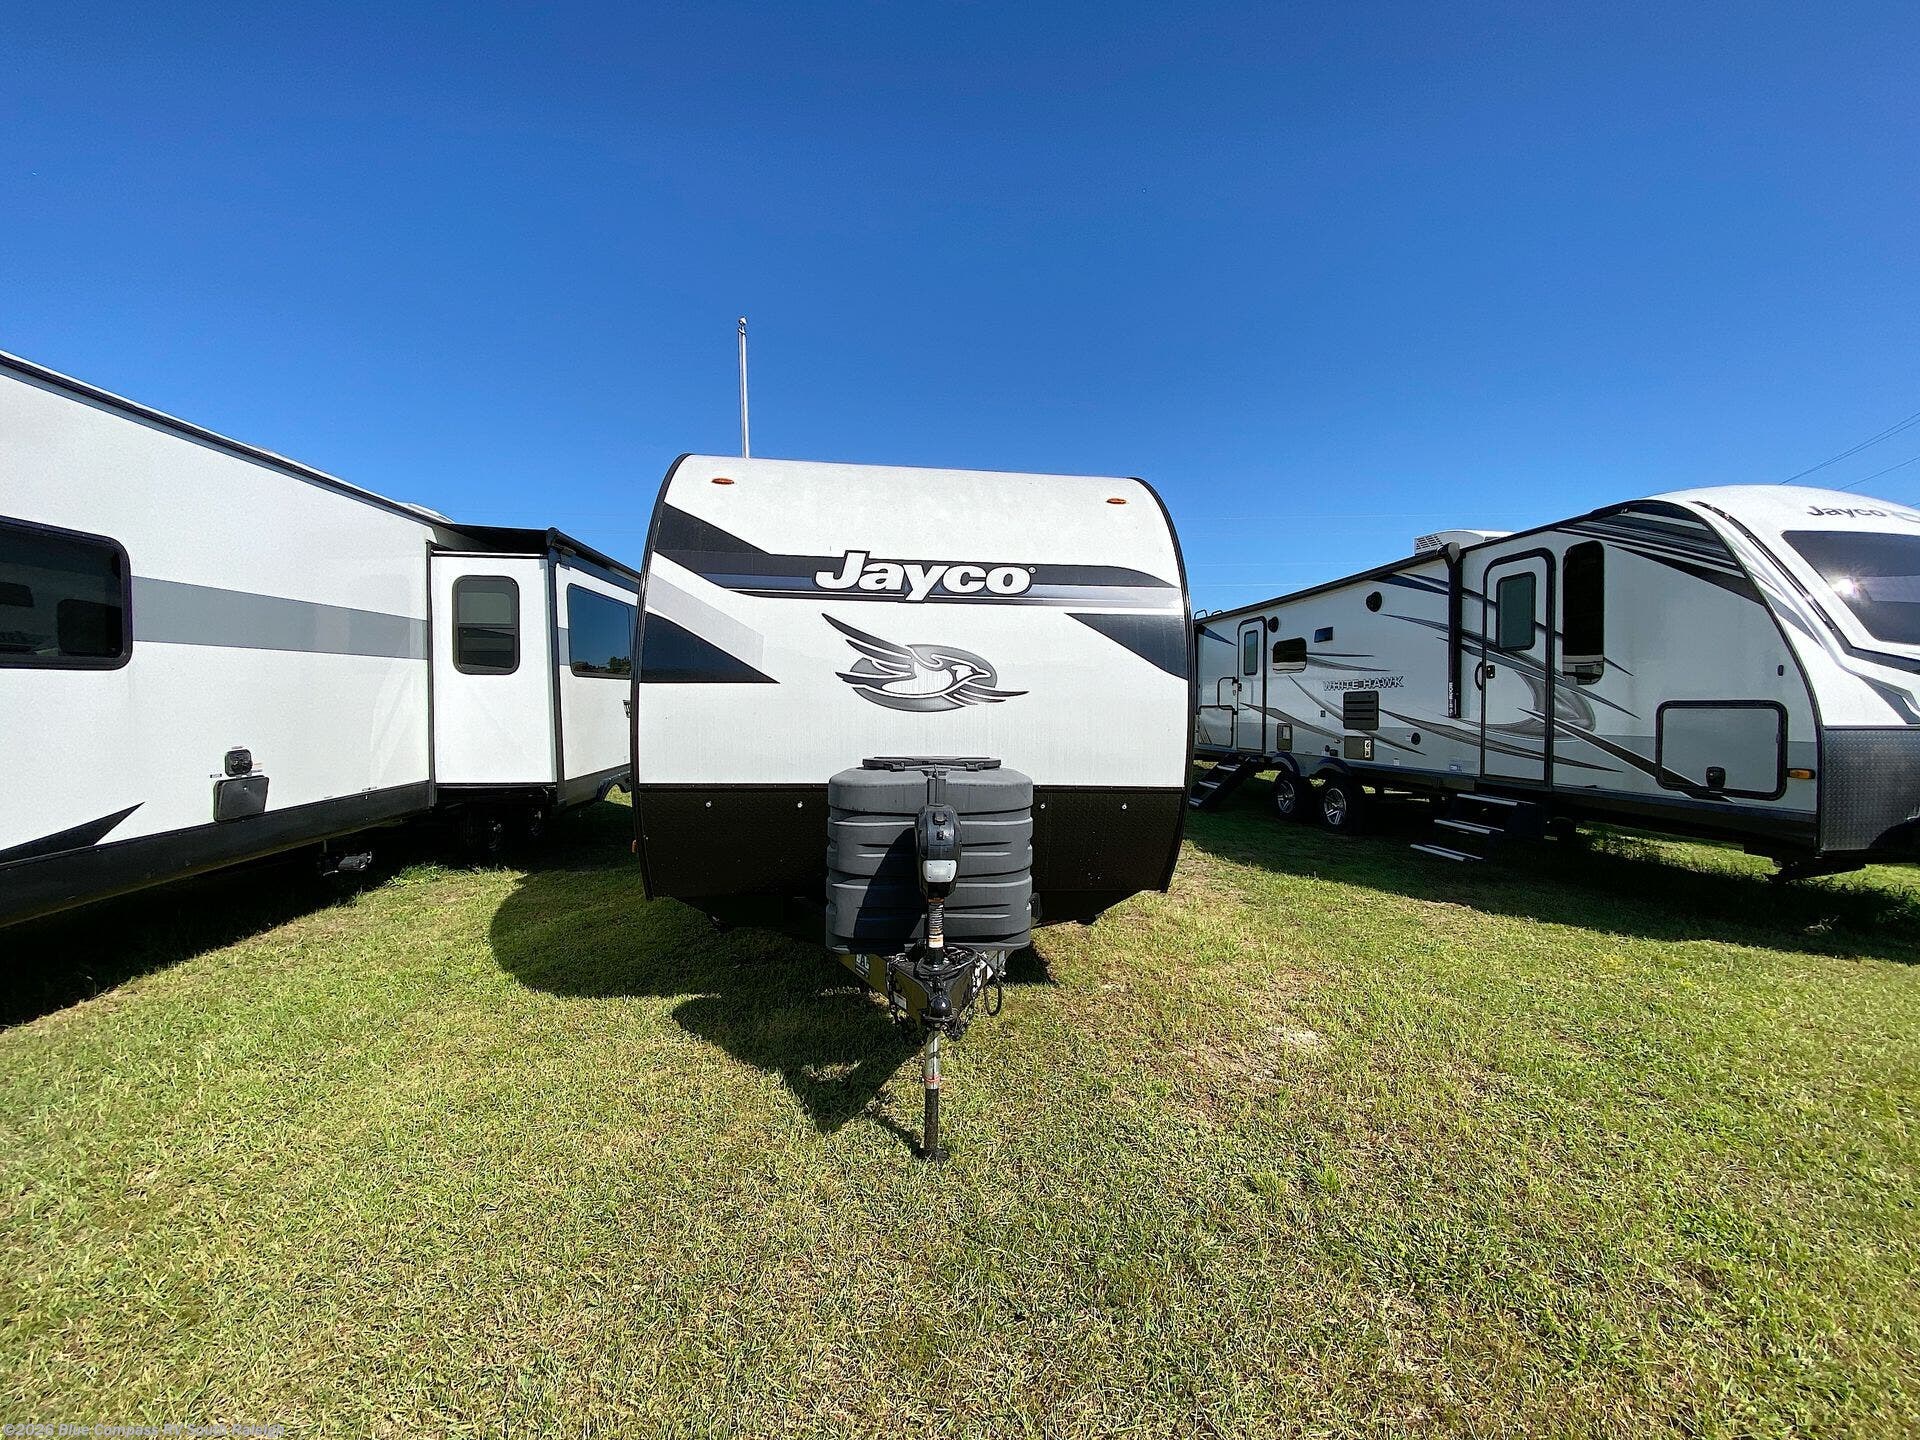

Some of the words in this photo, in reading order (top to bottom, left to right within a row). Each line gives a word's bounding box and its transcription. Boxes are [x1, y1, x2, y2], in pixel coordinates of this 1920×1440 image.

[1806, 505, 1887, 518] Jayco
[813, 549, 1031, 602] Jayco
[1323, 679, 1360, 691] WHITE
[1363, 676, 1404, 689] HAWK
